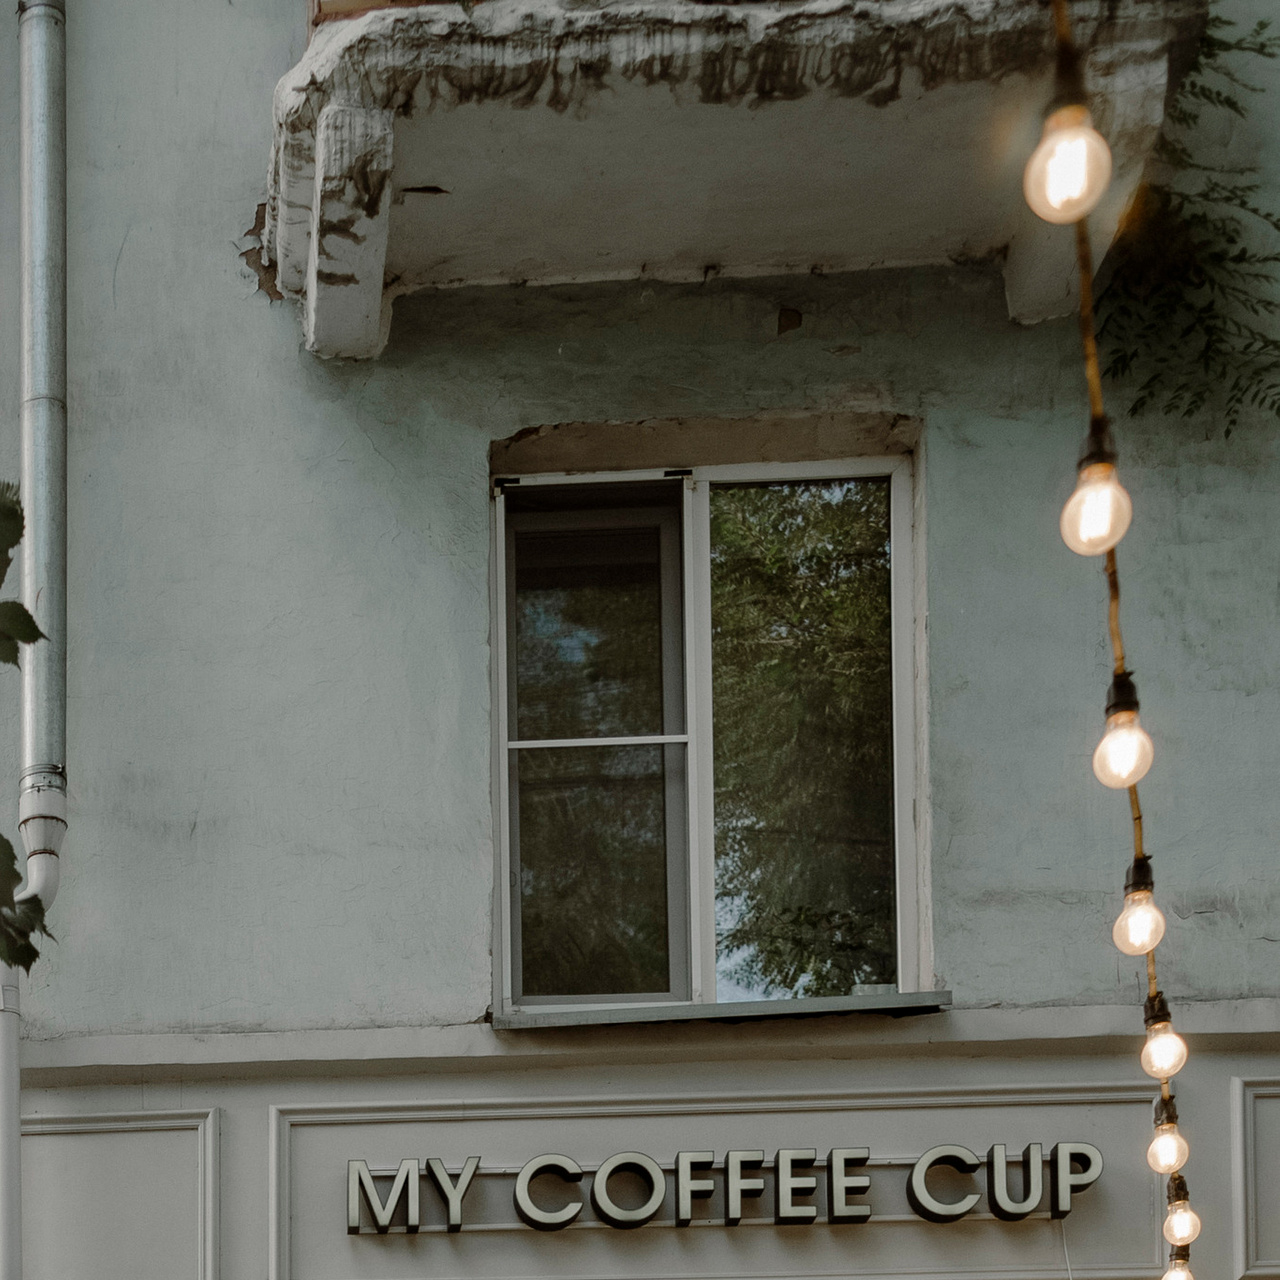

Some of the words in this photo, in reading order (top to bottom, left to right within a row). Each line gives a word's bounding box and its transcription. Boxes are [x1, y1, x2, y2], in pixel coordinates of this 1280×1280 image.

[347, 1156, 481, 1235] MY
[514, 1147, 871, 1230] COFFEE
[907, 1143, 1104, 1223] CUP
